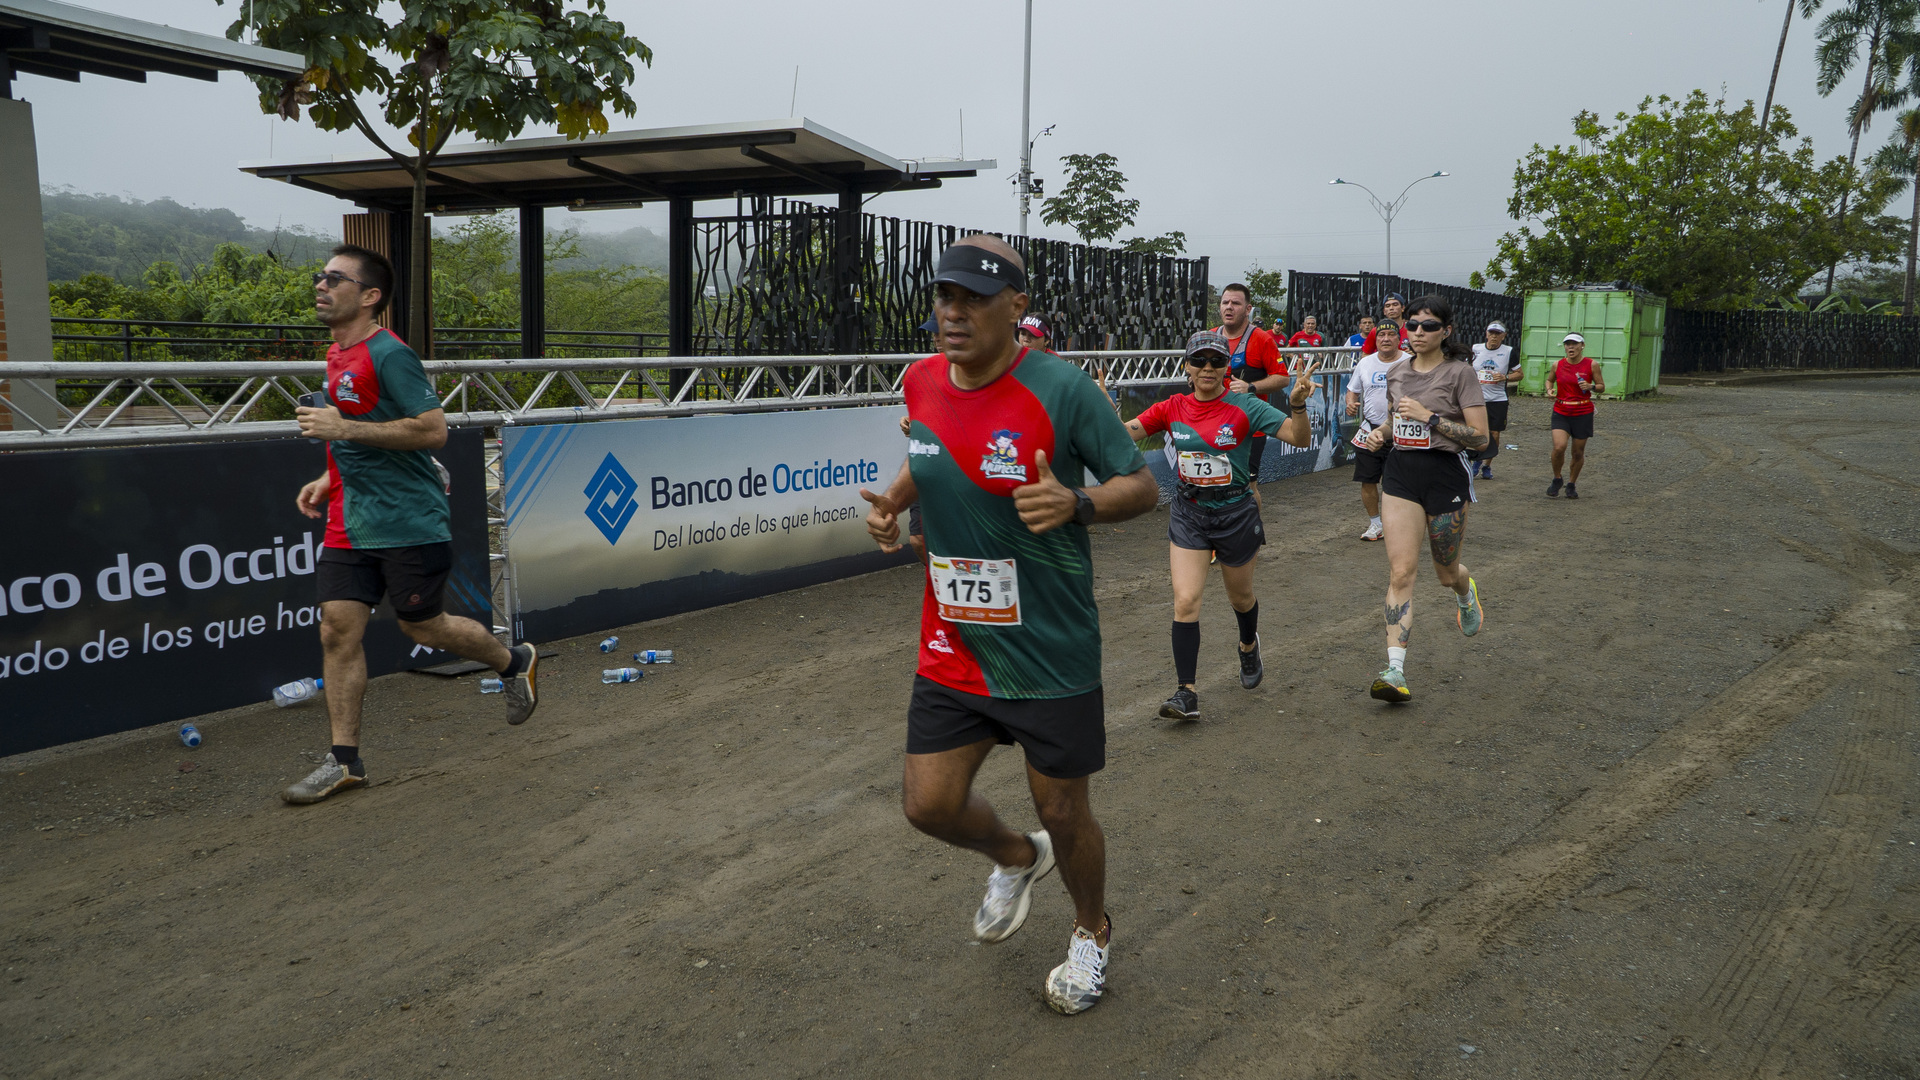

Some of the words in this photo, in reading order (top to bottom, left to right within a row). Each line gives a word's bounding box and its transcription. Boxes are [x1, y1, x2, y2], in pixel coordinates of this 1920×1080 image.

[1022, 315, 1042, 328] RUN
[1397, 423, 1422, 437] 1739
[651, 476, 732, 510] Banco
[738, 467, 767, 498] de
[772, 459, 878, 494] Occidente
[1193, 462, 1213, 476] 73
[653, 525, 682, 551] Del
[688, 520, 726, 545] lado
[730, 516, 750, 538] de
[755, 513, 777, 534] los
[781, 512, 809, 534] que
[812, 505, 859, 525] hacen.
[96, 552, 167, 602] de
[178, 531, 325, 590] Occid
[946, 578, 993, 604] 175
[80, 629, 130, 664] de
[142, 622, 194, 655] los
[204, 614, 267, 649] que
